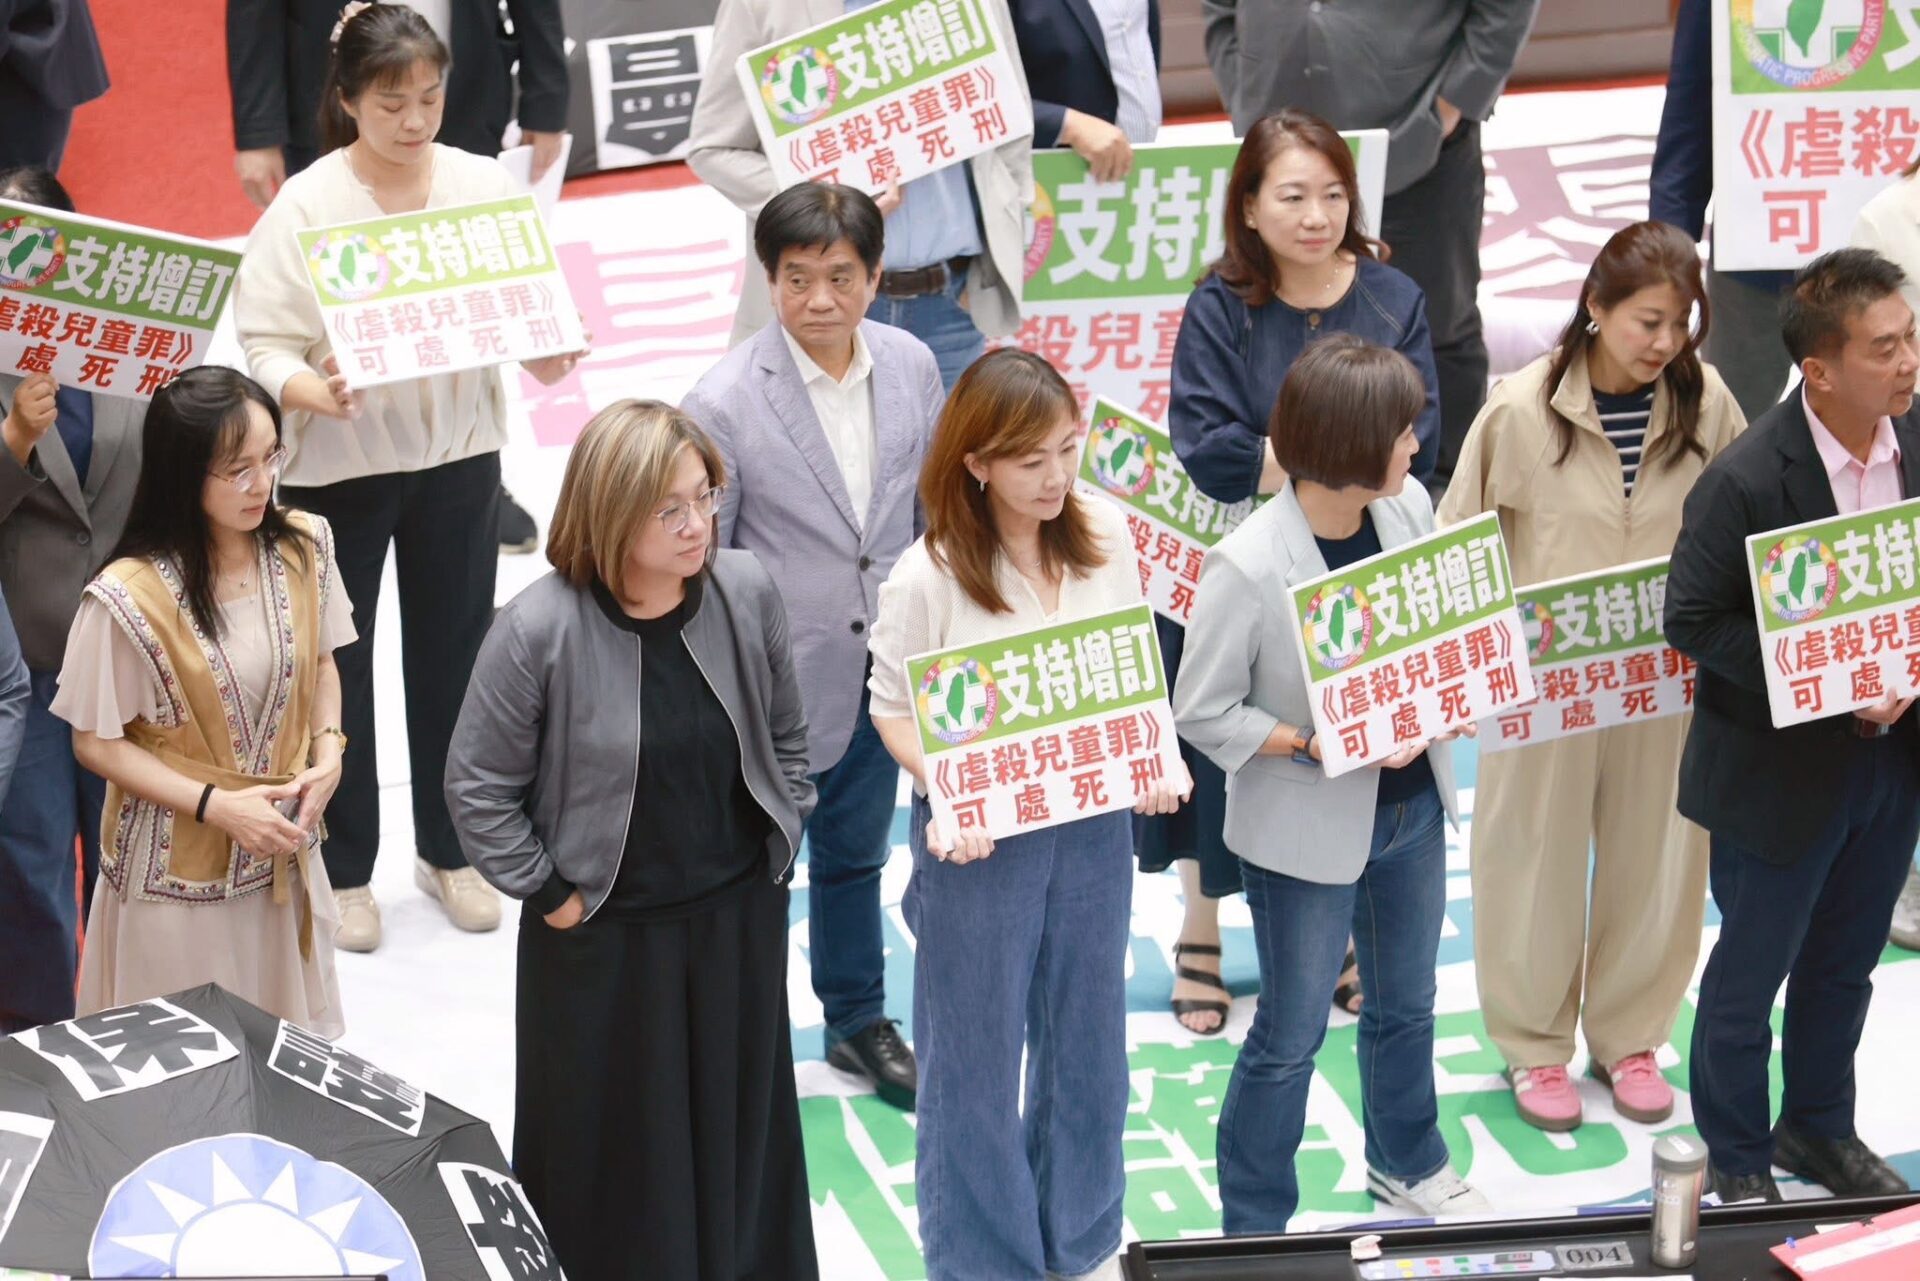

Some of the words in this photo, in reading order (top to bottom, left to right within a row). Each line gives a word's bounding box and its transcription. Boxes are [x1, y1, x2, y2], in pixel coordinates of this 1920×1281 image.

[827, 0, 986, 99] 支持增訂
[1862, 1, 1881, 44] PARTY
[789, 65, 994, 173] 《虐殺兒童罪》
[1740, 107, 1920, 179] 《虐殺
[380, 210, 546, 286] 支持增訂
[1763, 190, 1826, 254] 可
[53, 236, 234, 320] 支持增訂
[334, 281, 553, 344] 《虐殺兒童罪》
[16, 343, 180, 395] 處死刑
[354, 316, 564, 376] 可處死刑
[1367, 534, 1507, 647] 支持增訂
[1834, 516, 1920, 603] 支持
[992, 623, 1156, 725] 支持增訂
[1323, 620, 1511, 725] 《虐殺兒童罪》
[1338, 662, 1518, 759] 可處死刑
[1517, 647, 1698, 708] 殺兒童罪
[936, 711, 1159, 799] 《虐殺兒童罪》
[952, 753, 1163, 829] 可處死刑
[1566, 1246, 1622, 1264] 004
